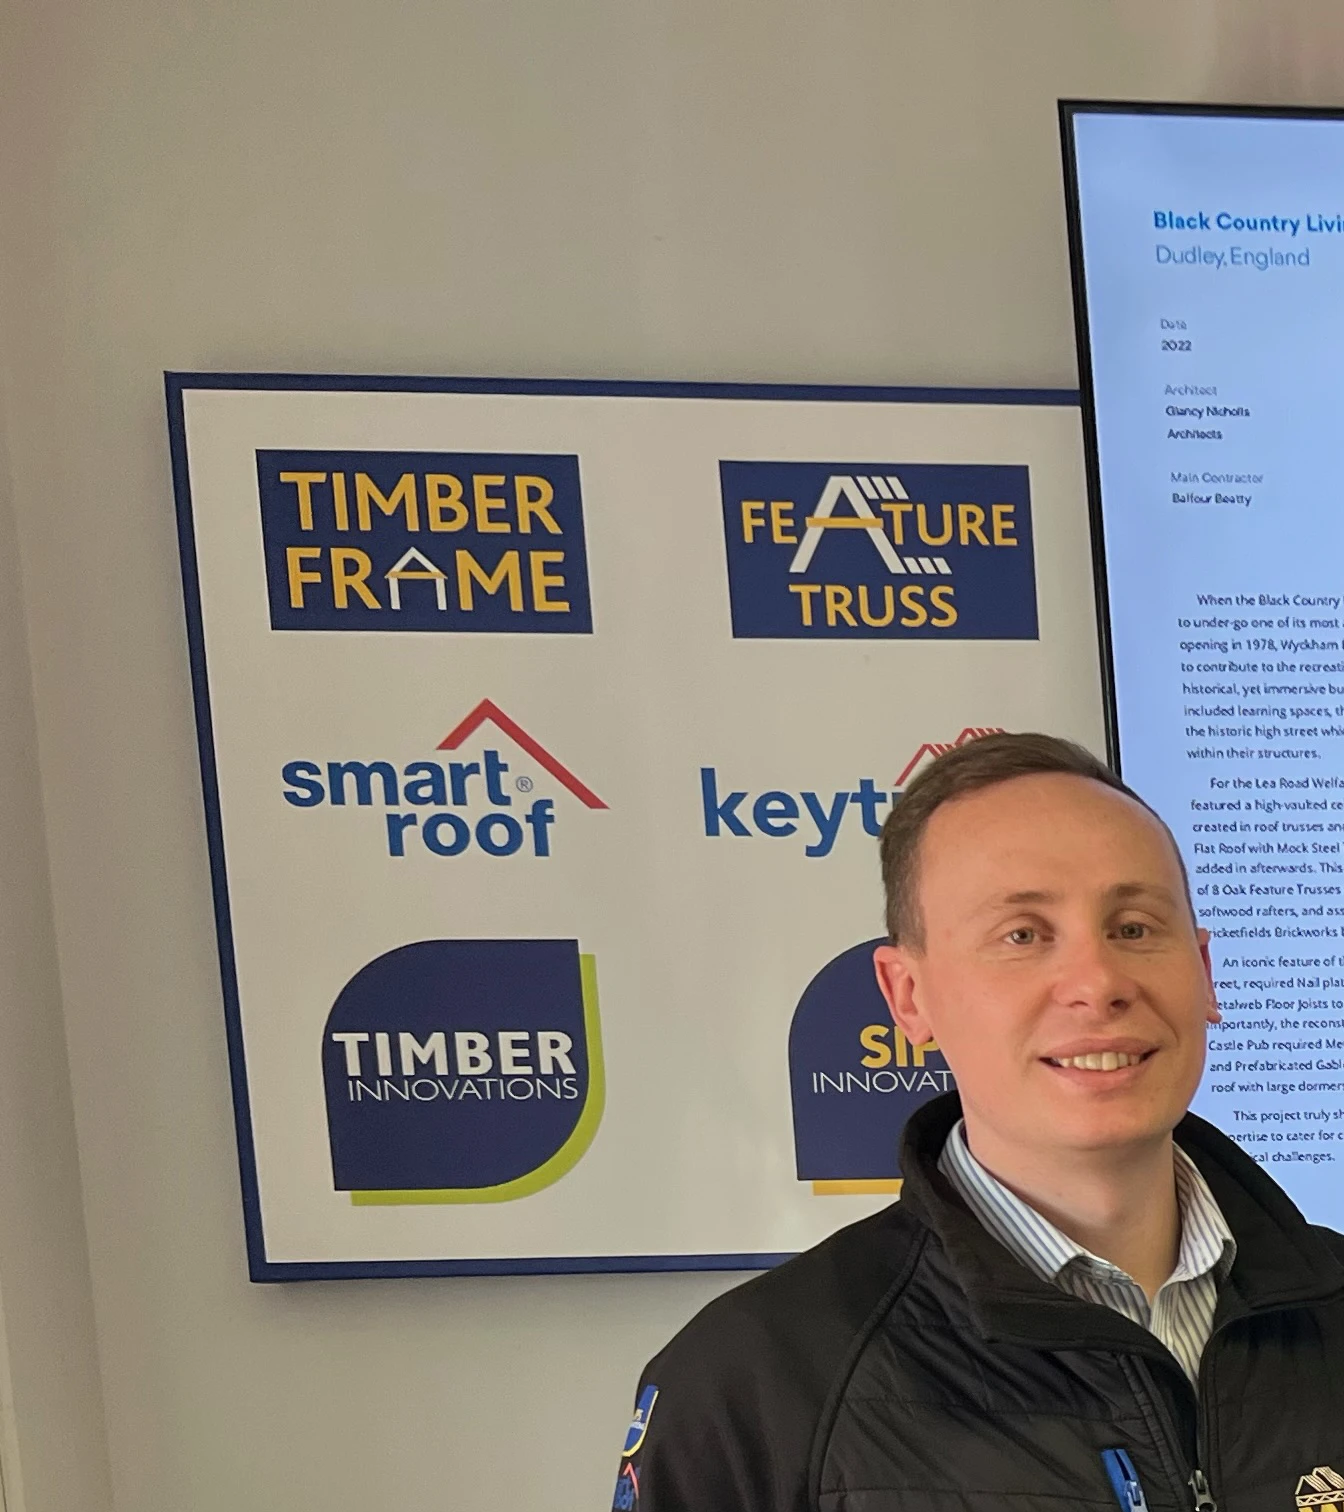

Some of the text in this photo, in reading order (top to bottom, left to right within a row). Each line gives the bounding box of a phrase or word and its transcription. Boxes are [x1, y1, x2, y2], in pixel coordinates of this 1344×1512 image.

[1153, 210, 1211, 230] Black
[1216, 212, 1300, 237] Country
[1155, 244, 1310, 272] Dudley, England
[1160, 318, 1188, 330] Date
[1161, 340, 1192, 352] 2022
[1164, 384, 1218, 396] Architect
[1167, 428, 1223, 440] Architects
[1170, 472, 1200, 484] Main
[280, 472, 562, 534] TIMBER
[1172, 492, 1252, 507] Balfour Beatty
[741, 475, 1018, 574] FEATURE
[285, 546, 570, 613] FRAME
[789, 584, 958, 629] TRUSS
[1196, 594, 1233, 606] When
[1235, 594, 1256, 606] the
[1258, 594, 1291, 606] Black
[1292, 594, 1341, 610] Country
[281, 750, 510, 808] smart
[700, 767, 904, 858] keyt
[386, 799, 556, 858] roof
[332, 1029, 577, 1079] TIMBER
[347, 1077, 580, 1104] INNOVATIONS
